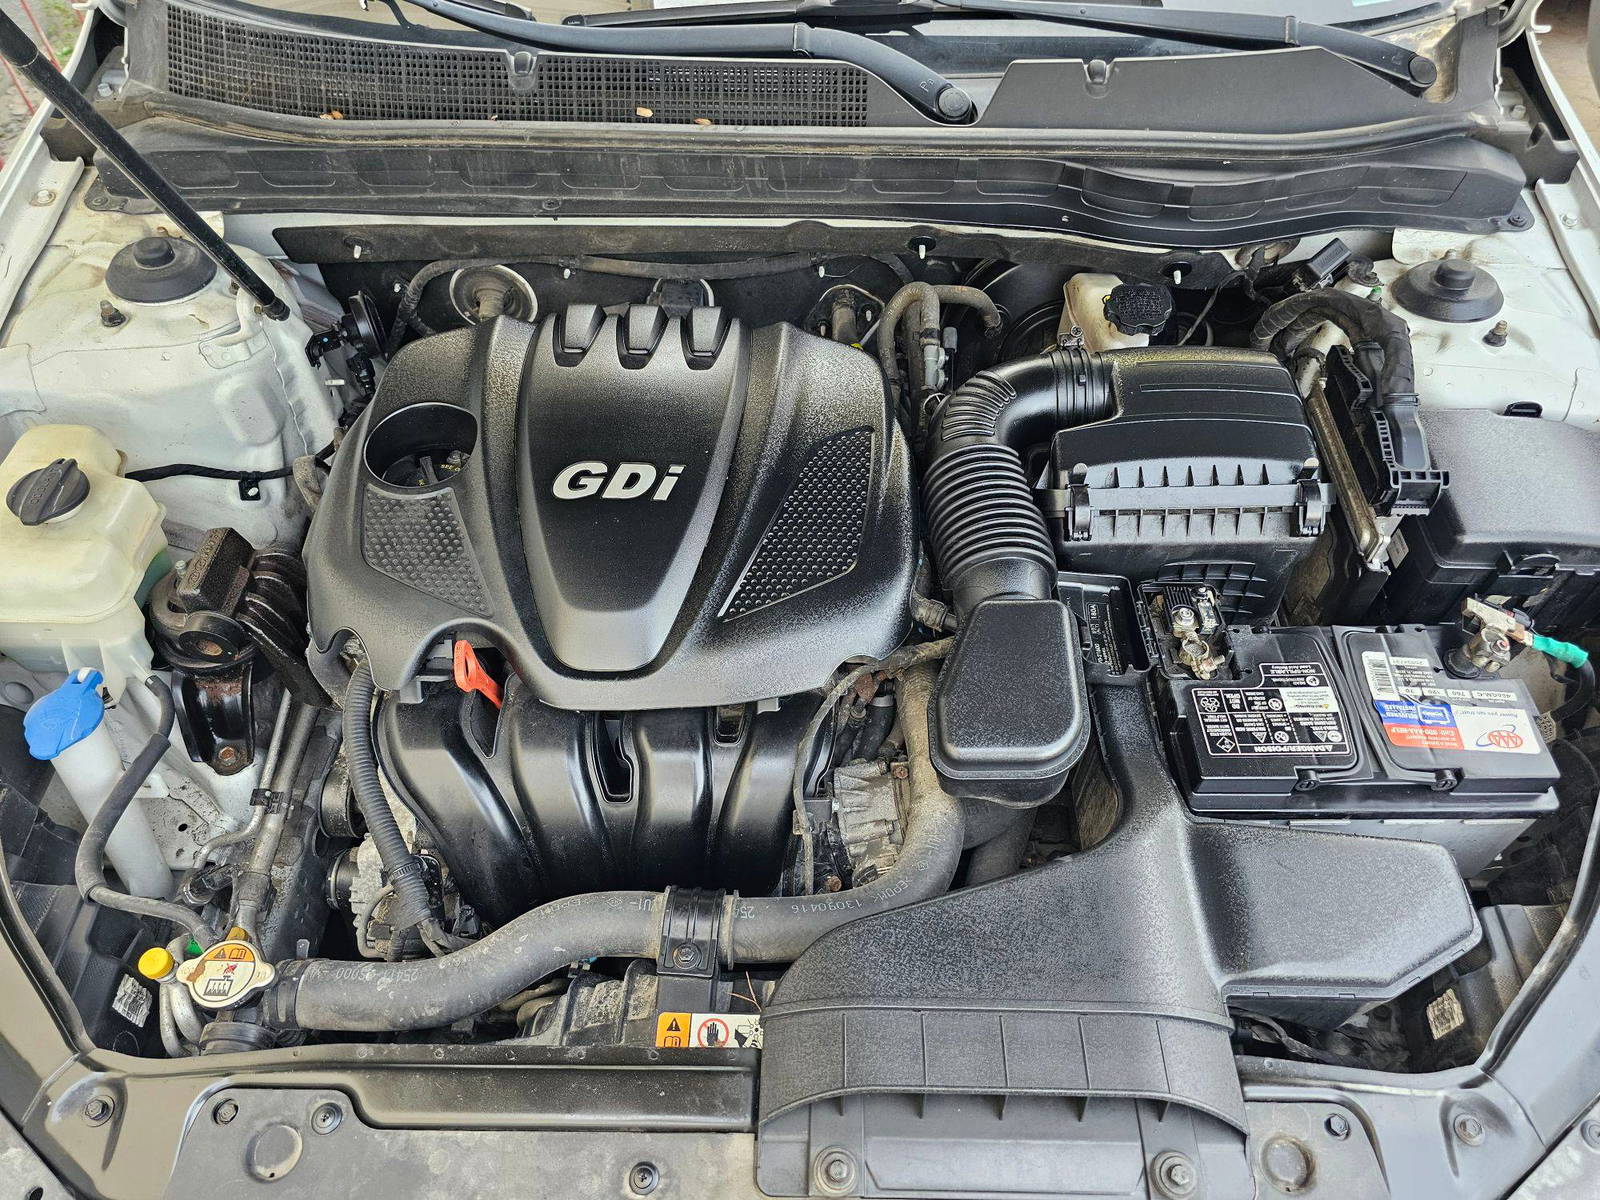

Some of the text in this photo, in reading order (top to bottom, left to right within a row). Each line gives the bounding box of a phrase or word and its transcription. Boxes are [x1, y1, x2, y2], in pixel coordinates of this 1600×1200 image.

[552, 460, 686, 501] GDi
[1253, 744, 1327, 752] DANGER/POISON
[1489, 731, 1521, 748] AAA
[791, 898, 863, 915] 13090416
